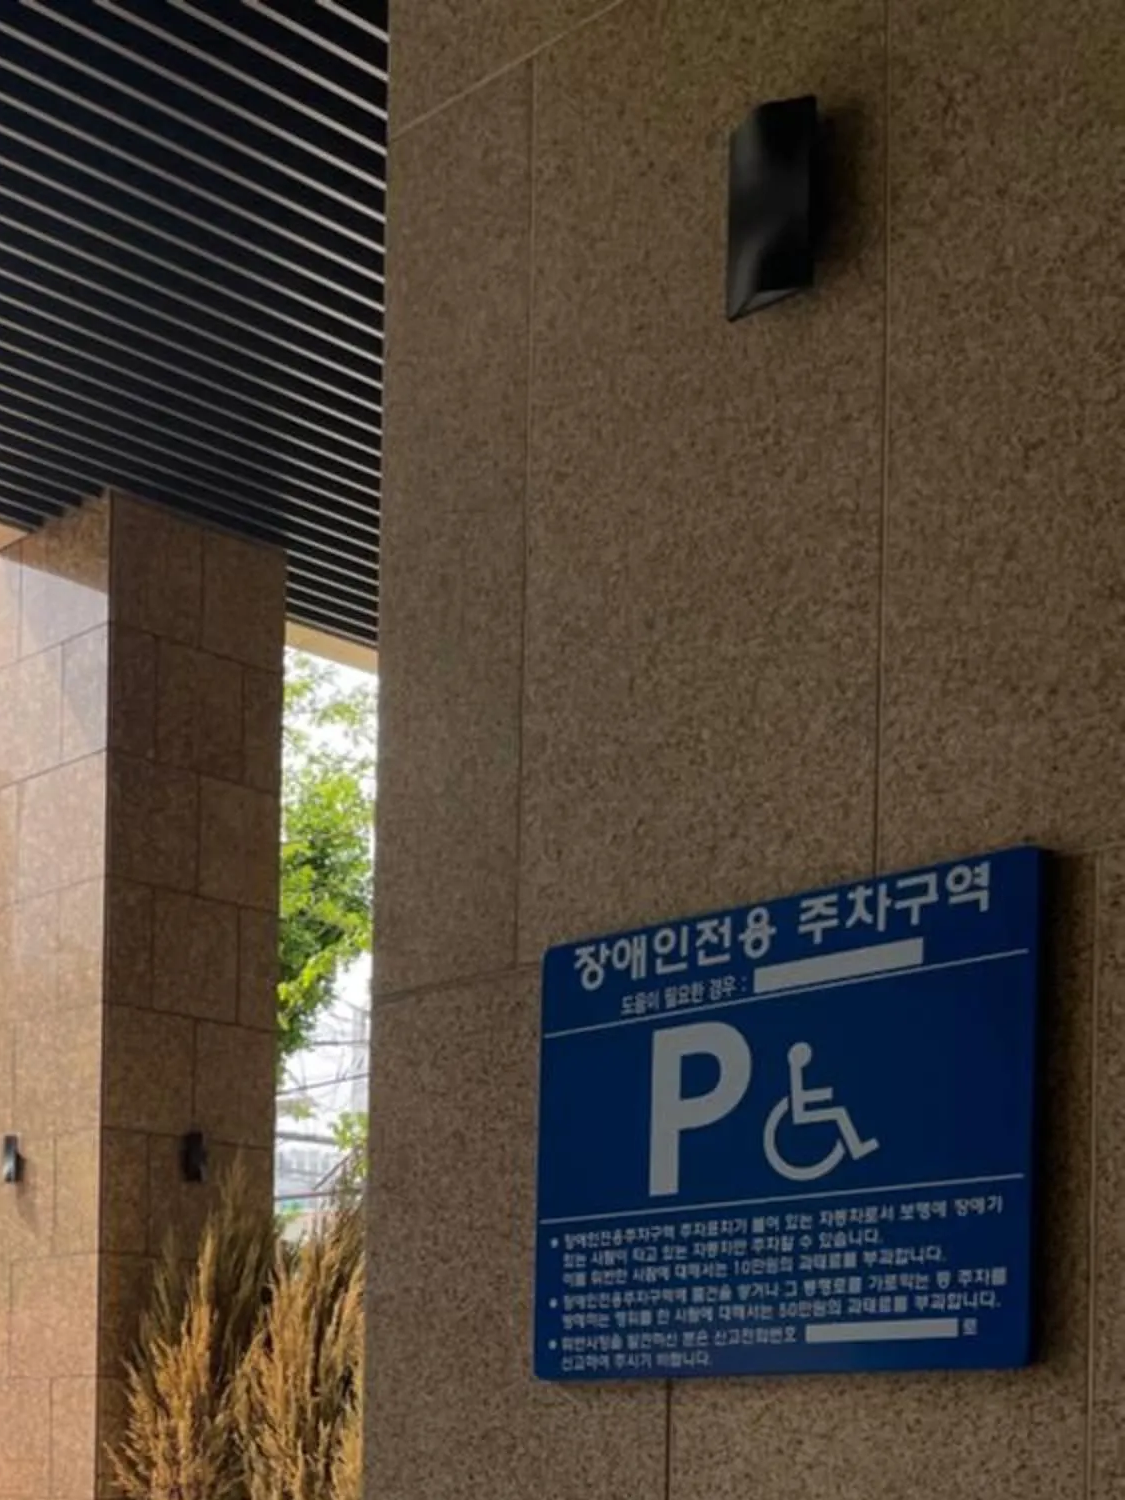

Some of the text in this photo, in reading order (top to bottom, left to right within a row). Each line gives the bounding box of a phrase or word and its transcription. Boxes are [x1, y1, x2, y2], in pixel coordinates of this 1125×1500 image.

[574, 861, 992, 992] 장애인전용 주차구역
[649, 1021, 752, 1197] P
